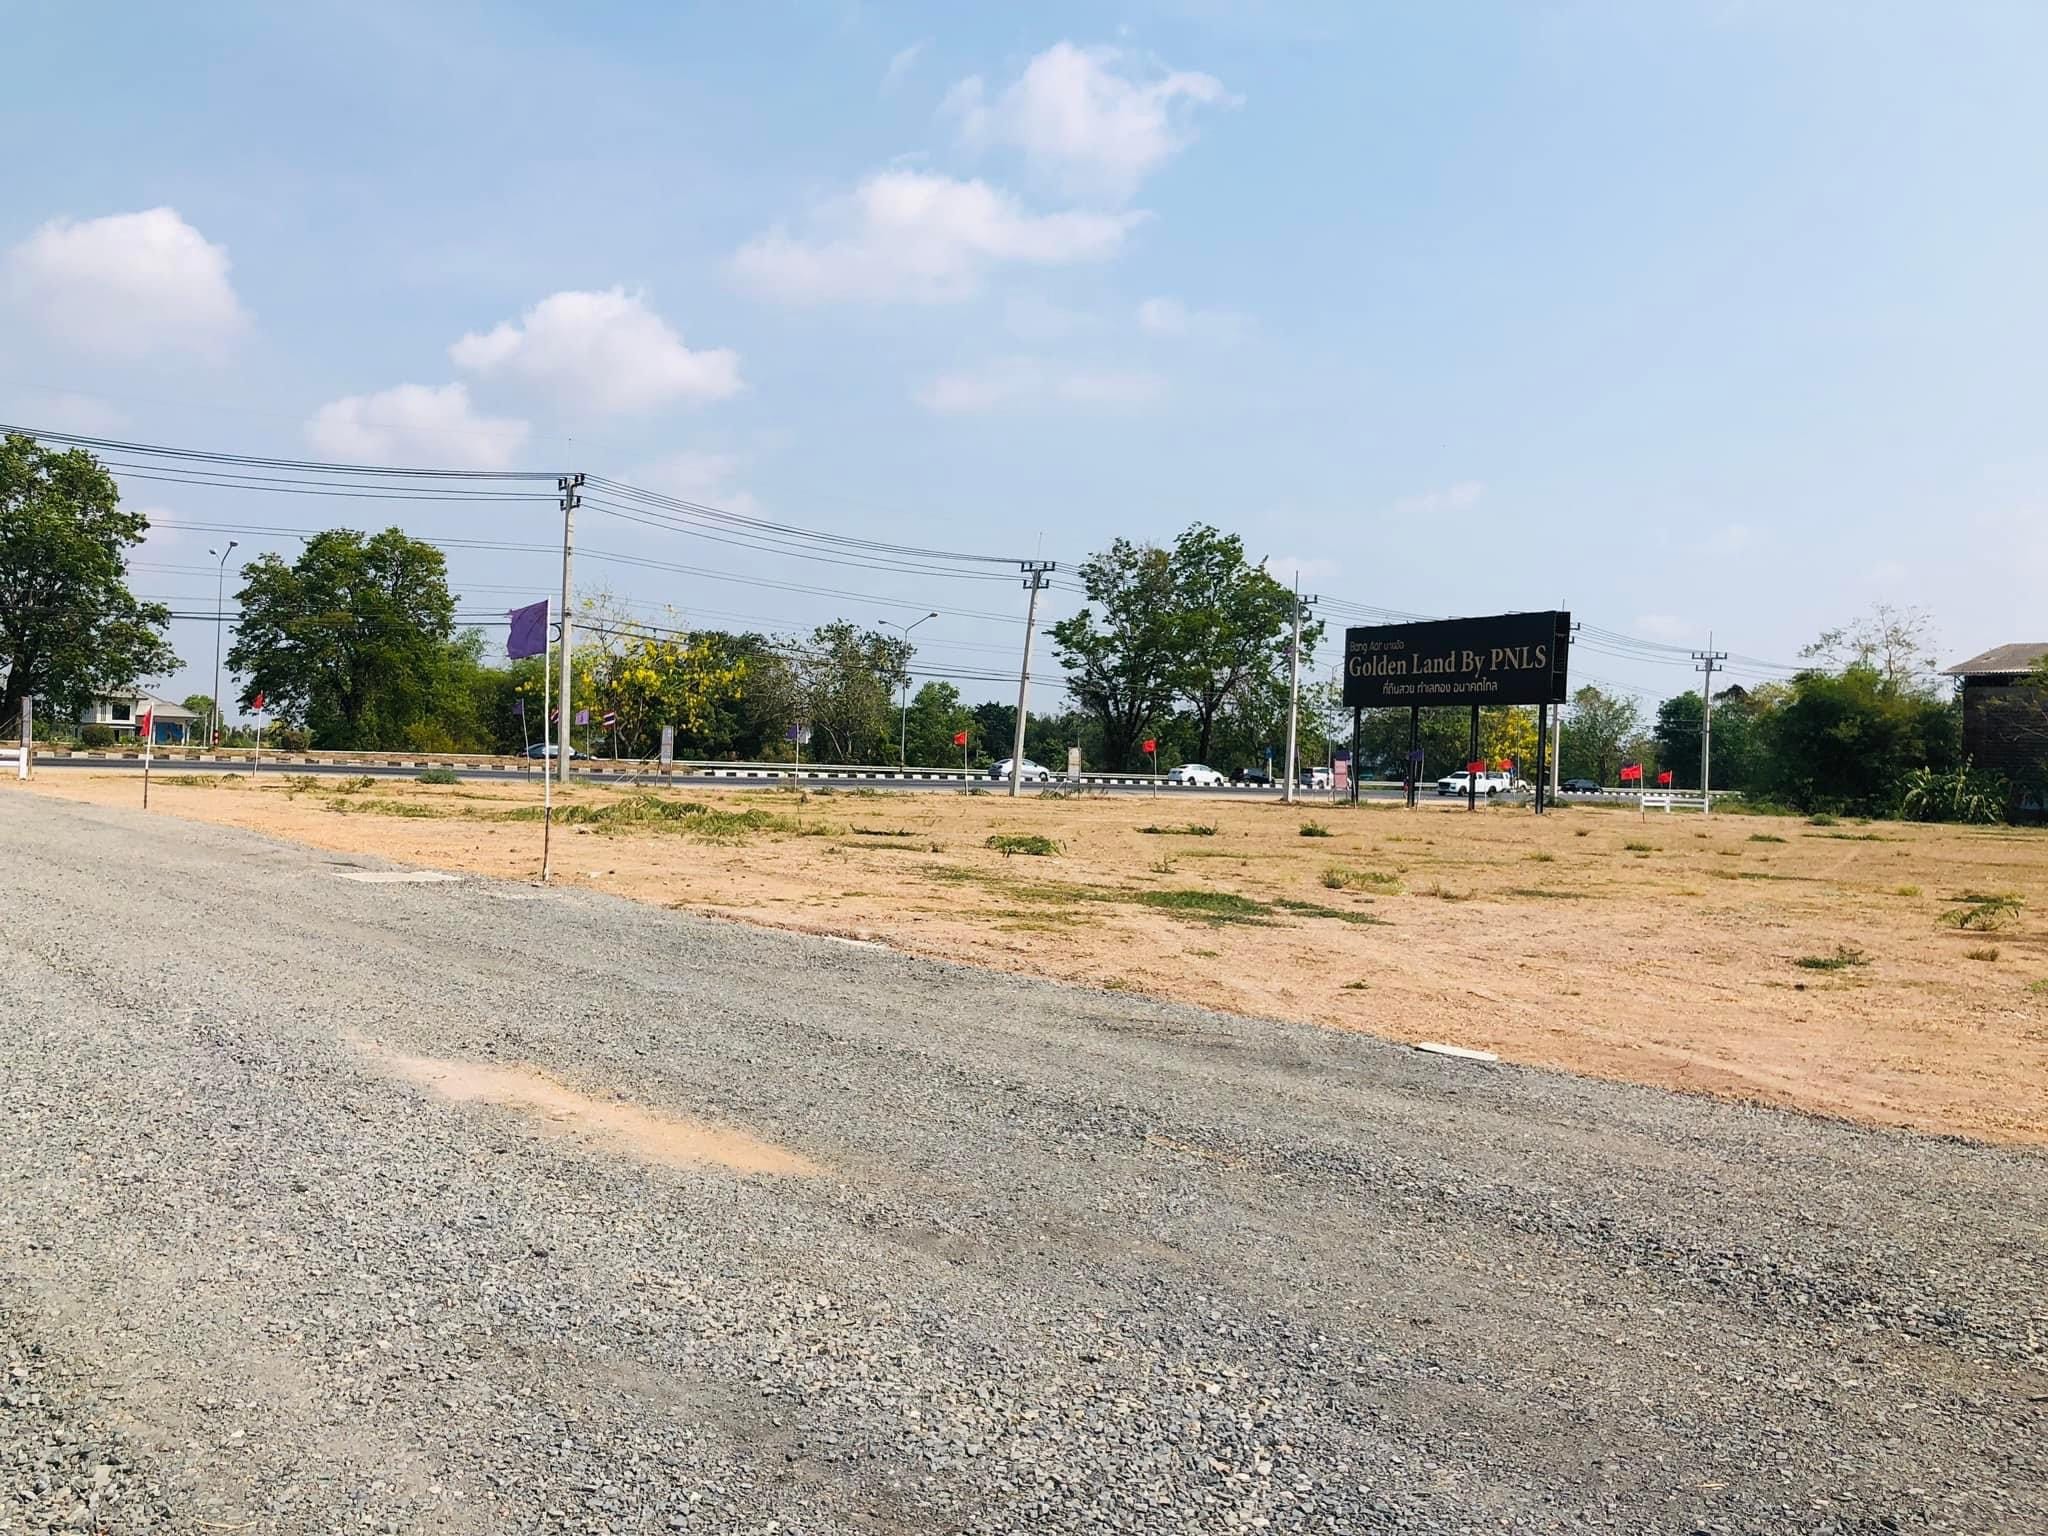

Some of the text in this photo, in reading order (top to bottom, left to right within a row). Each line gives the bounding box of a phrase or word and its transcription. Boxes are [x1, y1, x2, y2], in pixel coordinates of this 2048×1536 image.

[1349, 645, 1546, 678] Golden Land By PNLS
